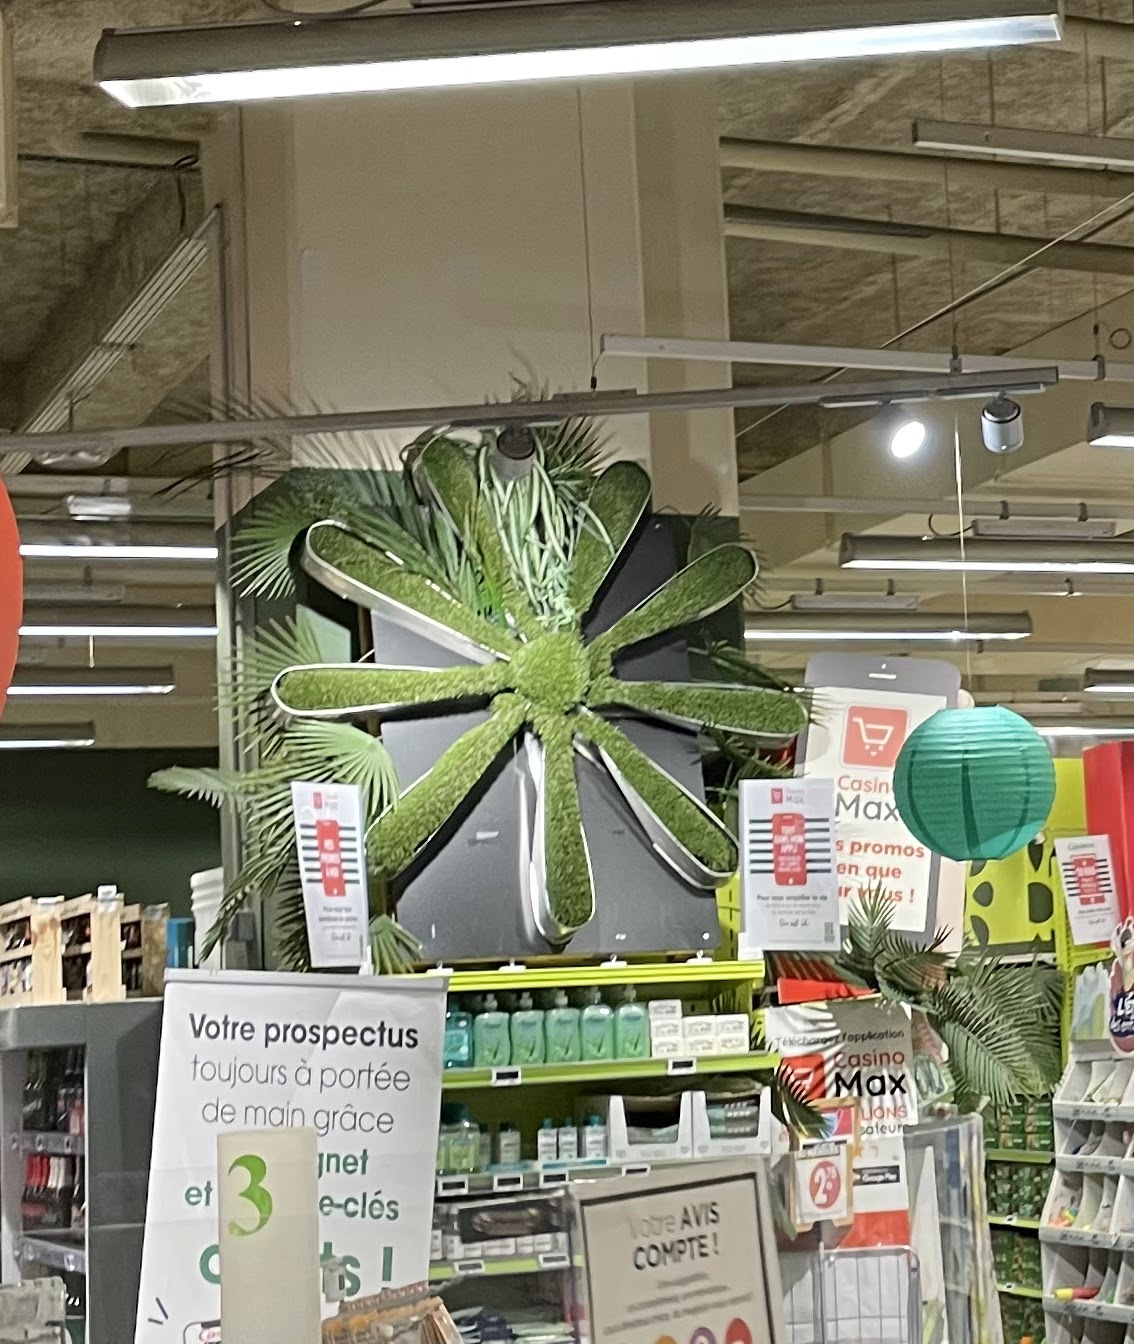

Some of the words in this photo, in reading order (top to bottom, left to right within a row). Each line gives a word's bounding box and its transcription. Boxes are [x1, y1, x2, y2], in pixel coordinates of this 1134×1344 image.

[838, 775, 891, 794] Casin
[835, 793, 899, 822] Max
[850, 841, 925, 858] promos
[865, 863, 902, 880] que
[189, 1013, 256, 1044] Votre
[263, 1017, 420, 1051] prospectus
[834, 1049, 905, 1069] Casino
[190, 1055, 288, 1090] toujours
[293, 1059, 313, 1087] à
[319, 1060, 411, 1098] portée
[834, 1071, 907, 1098] Max
[201, 1097, 236, 1124] de
[243, 1100, 307, 1129] main
[313, 1100, 395, 1138] grâce
[861, 1104, 908, 1122] LIONS
[184, 1181, 212, 1207] et
[319, 1190, 400, 1221] e-clés
[227, 1154, 274, 1238] 3
[680, 1201, 721, 1230] AVIS
[633, 1235, 710, 1272] COMPTE
